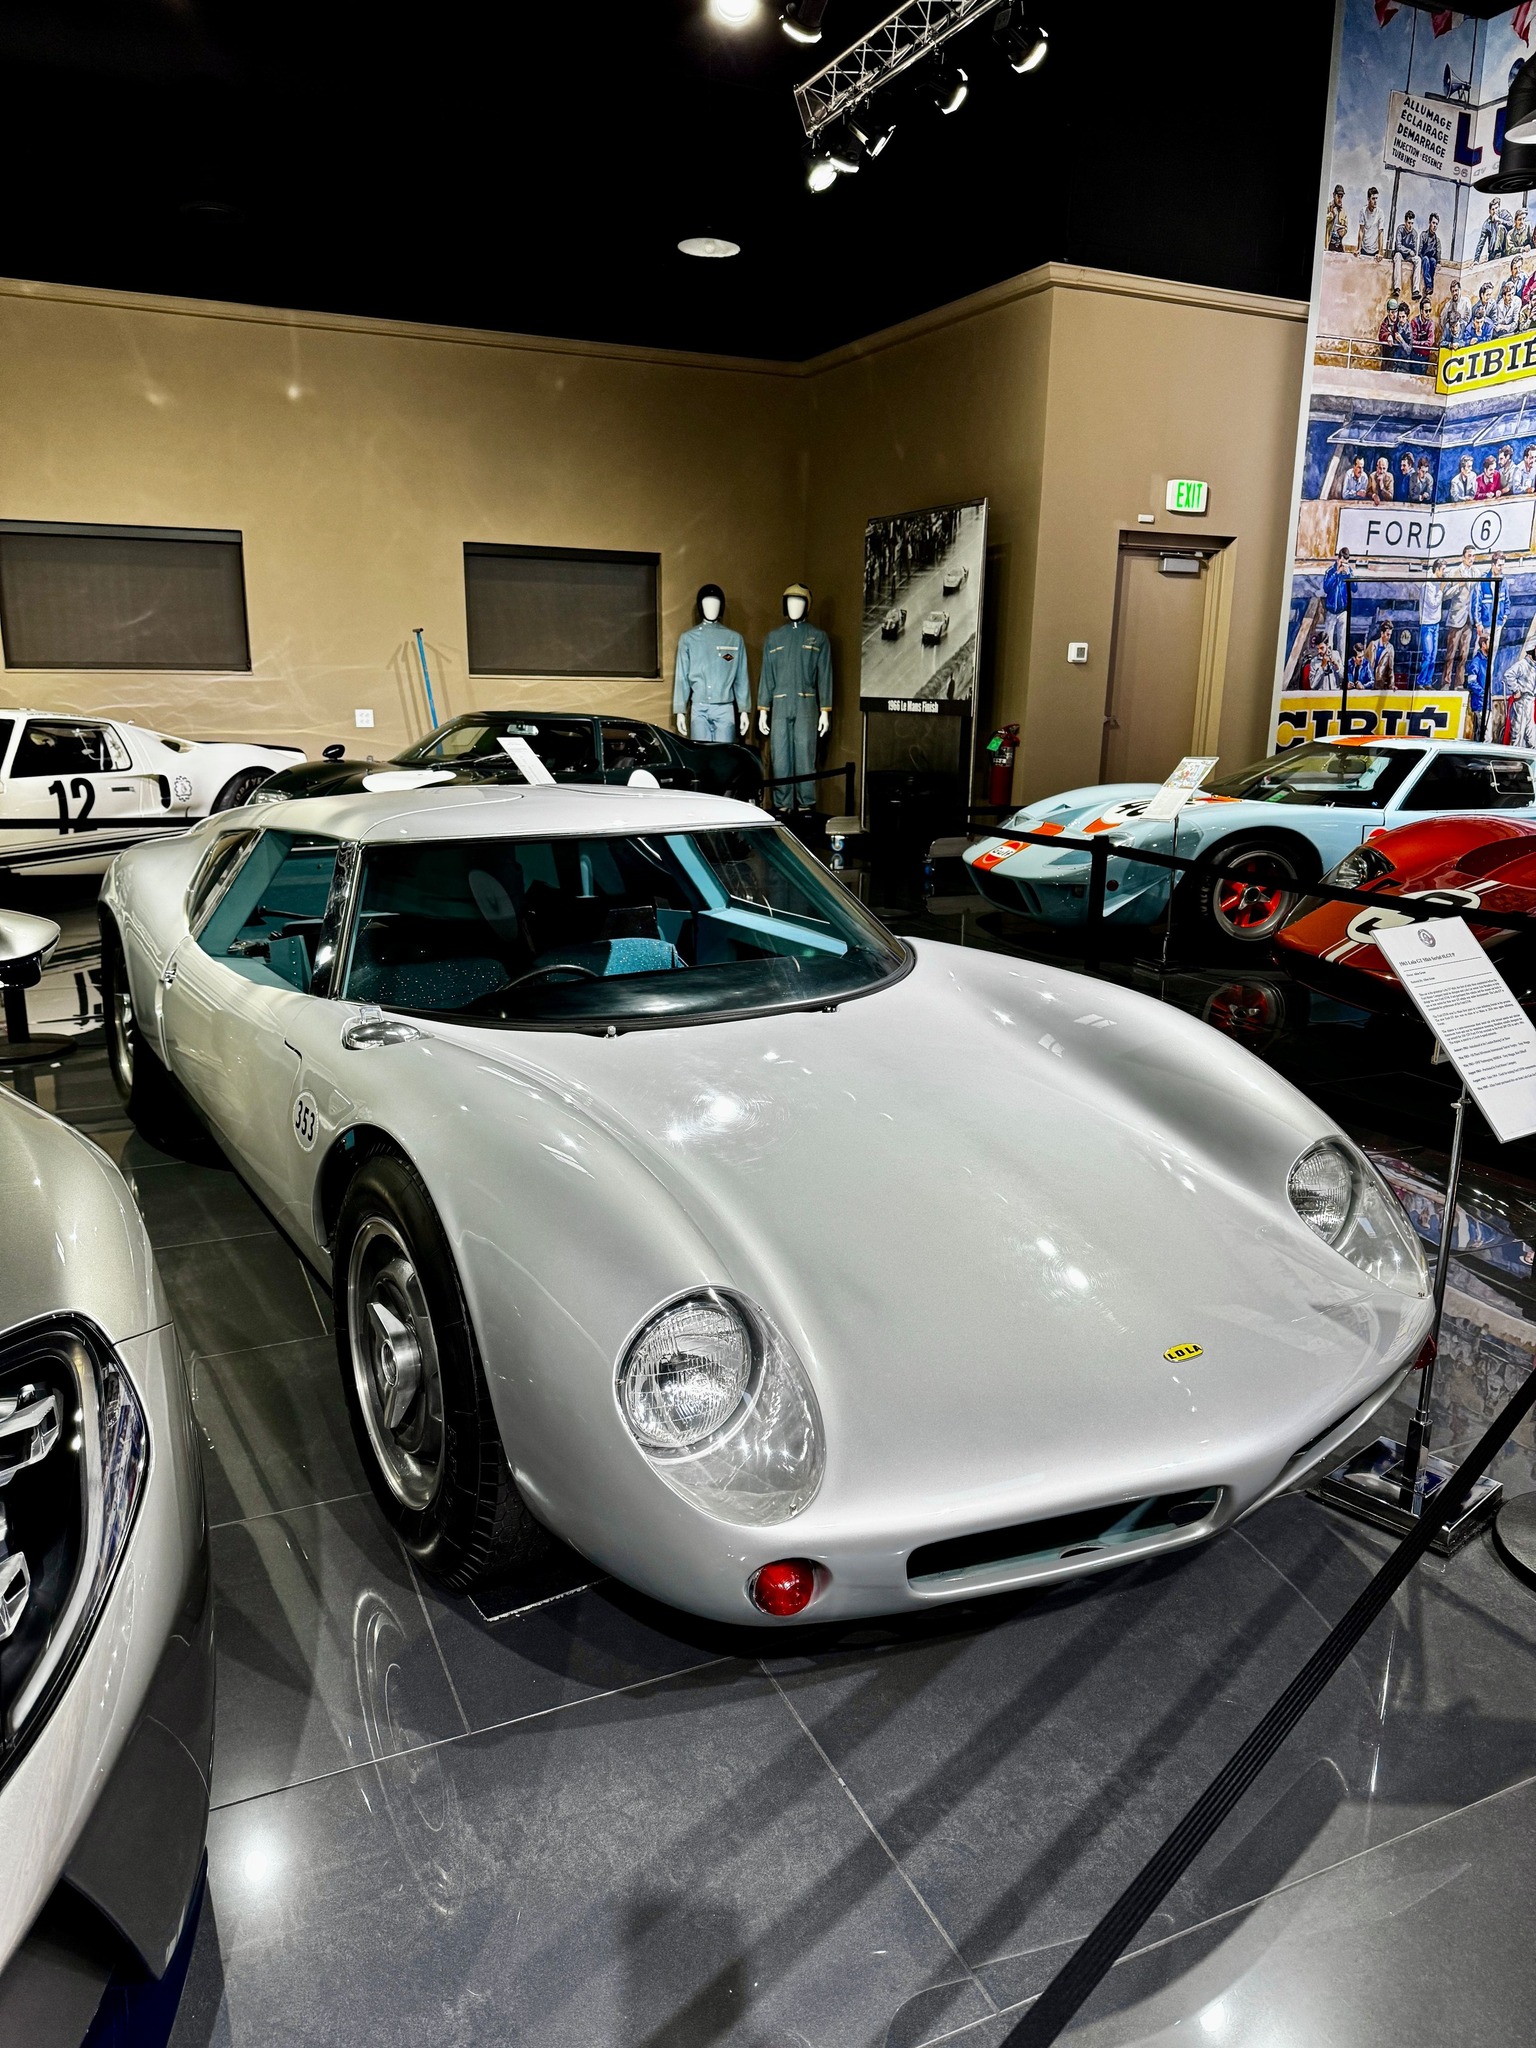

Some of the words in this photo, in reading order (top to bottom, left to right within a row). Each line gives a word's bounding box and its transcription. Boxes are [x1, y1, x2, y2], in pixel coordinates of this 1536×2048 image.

[1400, 109, 1449, 145] ÉCLAIRAGE
[1403, 96, 1452, 131] ALLUMAGE
[1393, 137, 1420, 158] INJECTION
[1421, 153, 1443, 171] ESSENCE
[1397, 122, 1446, 158] DEMARRAGE
[1391, 147, 1416, 168] TURBINES
[1453, 166, 1469, 178] 96
[1176, 482, 1203, 508] EXIT
[1366, 520, 1445, 549] FORD
[1480, 519, 1491, 541] 6
[888, 700, 900, 711] 1966
[900, 700, 906, 711] Le
[907, 700, 921, 712] Mans
[922, 701, 939, 713] Finish
[48, 777, 97, 835] 12
[295, 1100, 315, 1142] 353
[1167, 1345, 1202, 1360] LOLA
